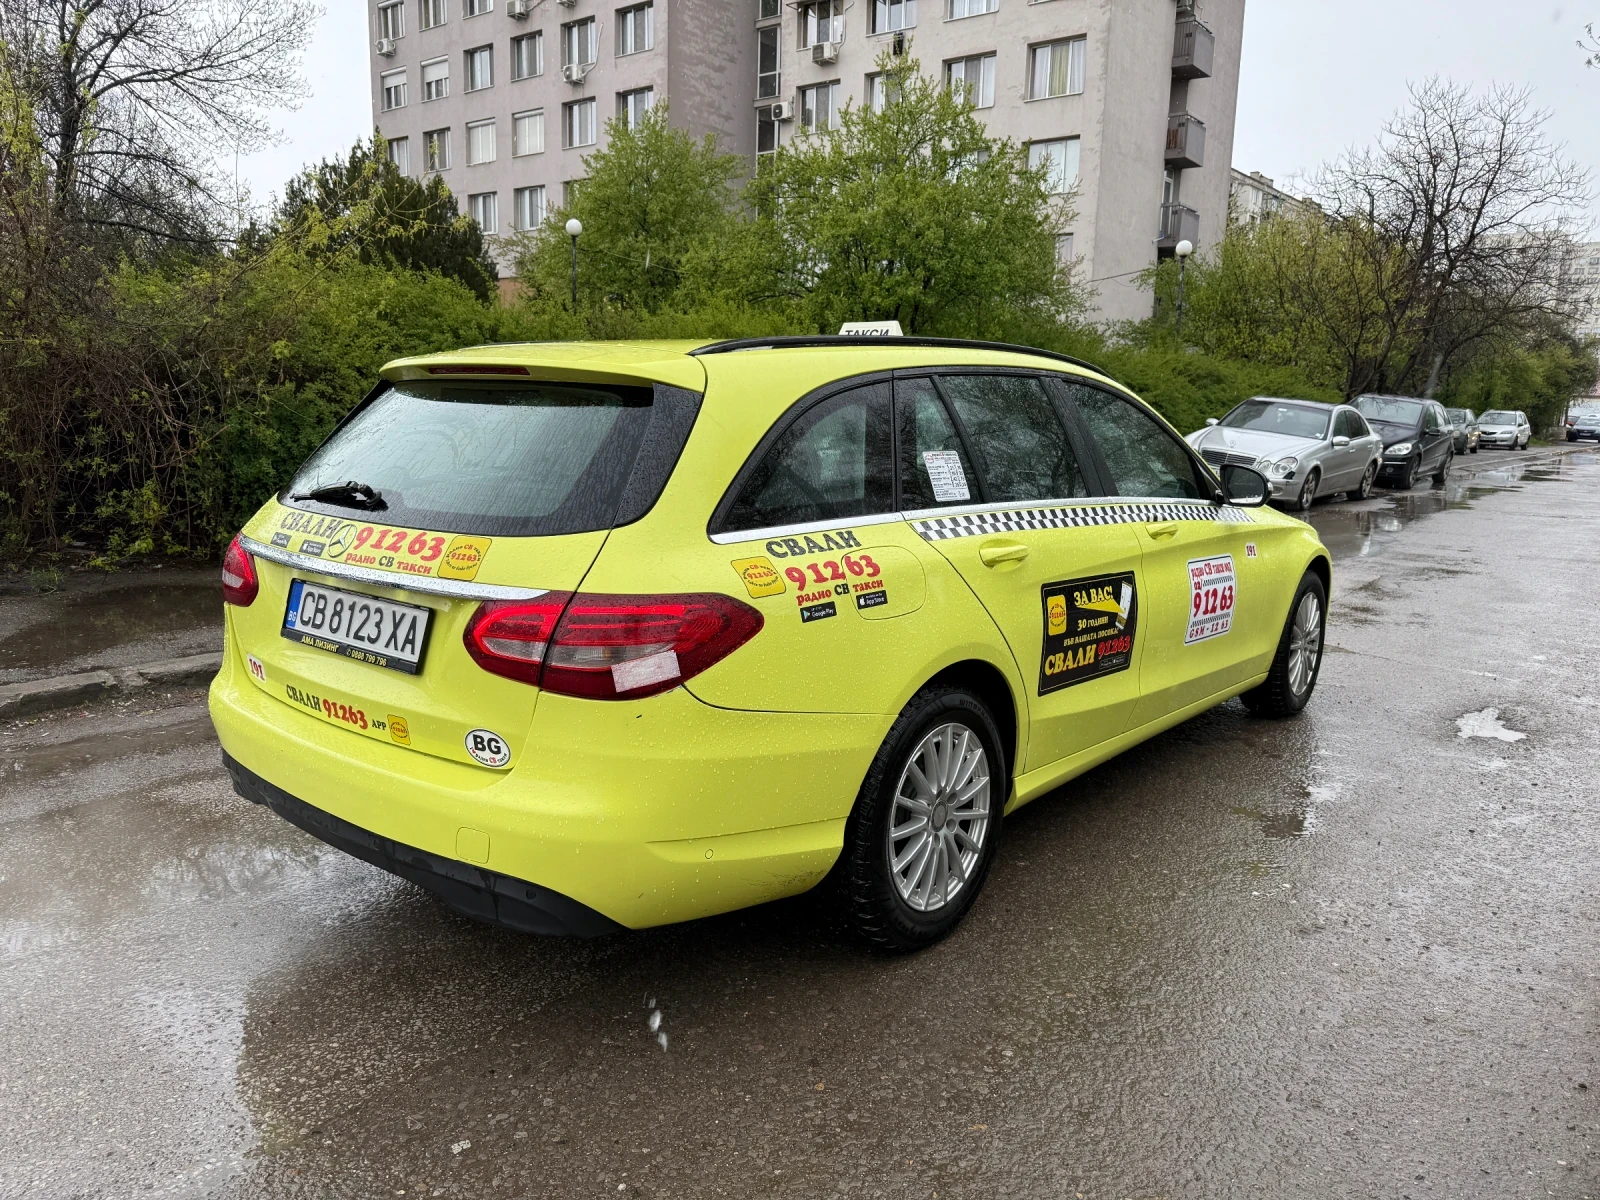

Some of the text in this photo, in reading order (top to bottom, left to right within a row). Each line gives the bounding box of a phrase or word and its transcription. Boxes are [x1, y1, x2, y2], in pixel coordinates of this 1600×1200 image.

[280, 511, 342, 539] СВАЛИ
[766, 530, 862, 559] СВАЛИ
[1246, 545, 1257, 557] 191
[1073, 590, 1089, 606] ЗА
[287, 611, 297, 623] BG
[1045, 644, 1096, 676] СВАЛИ
[1097, 635, 1131, 659] 91263
[249, 658, 265, 681] 191
[286, 683, 322, 712] СВАЛИ
[322, 698, 369, 730] 91263
[473, 733, 502, 755] BG
